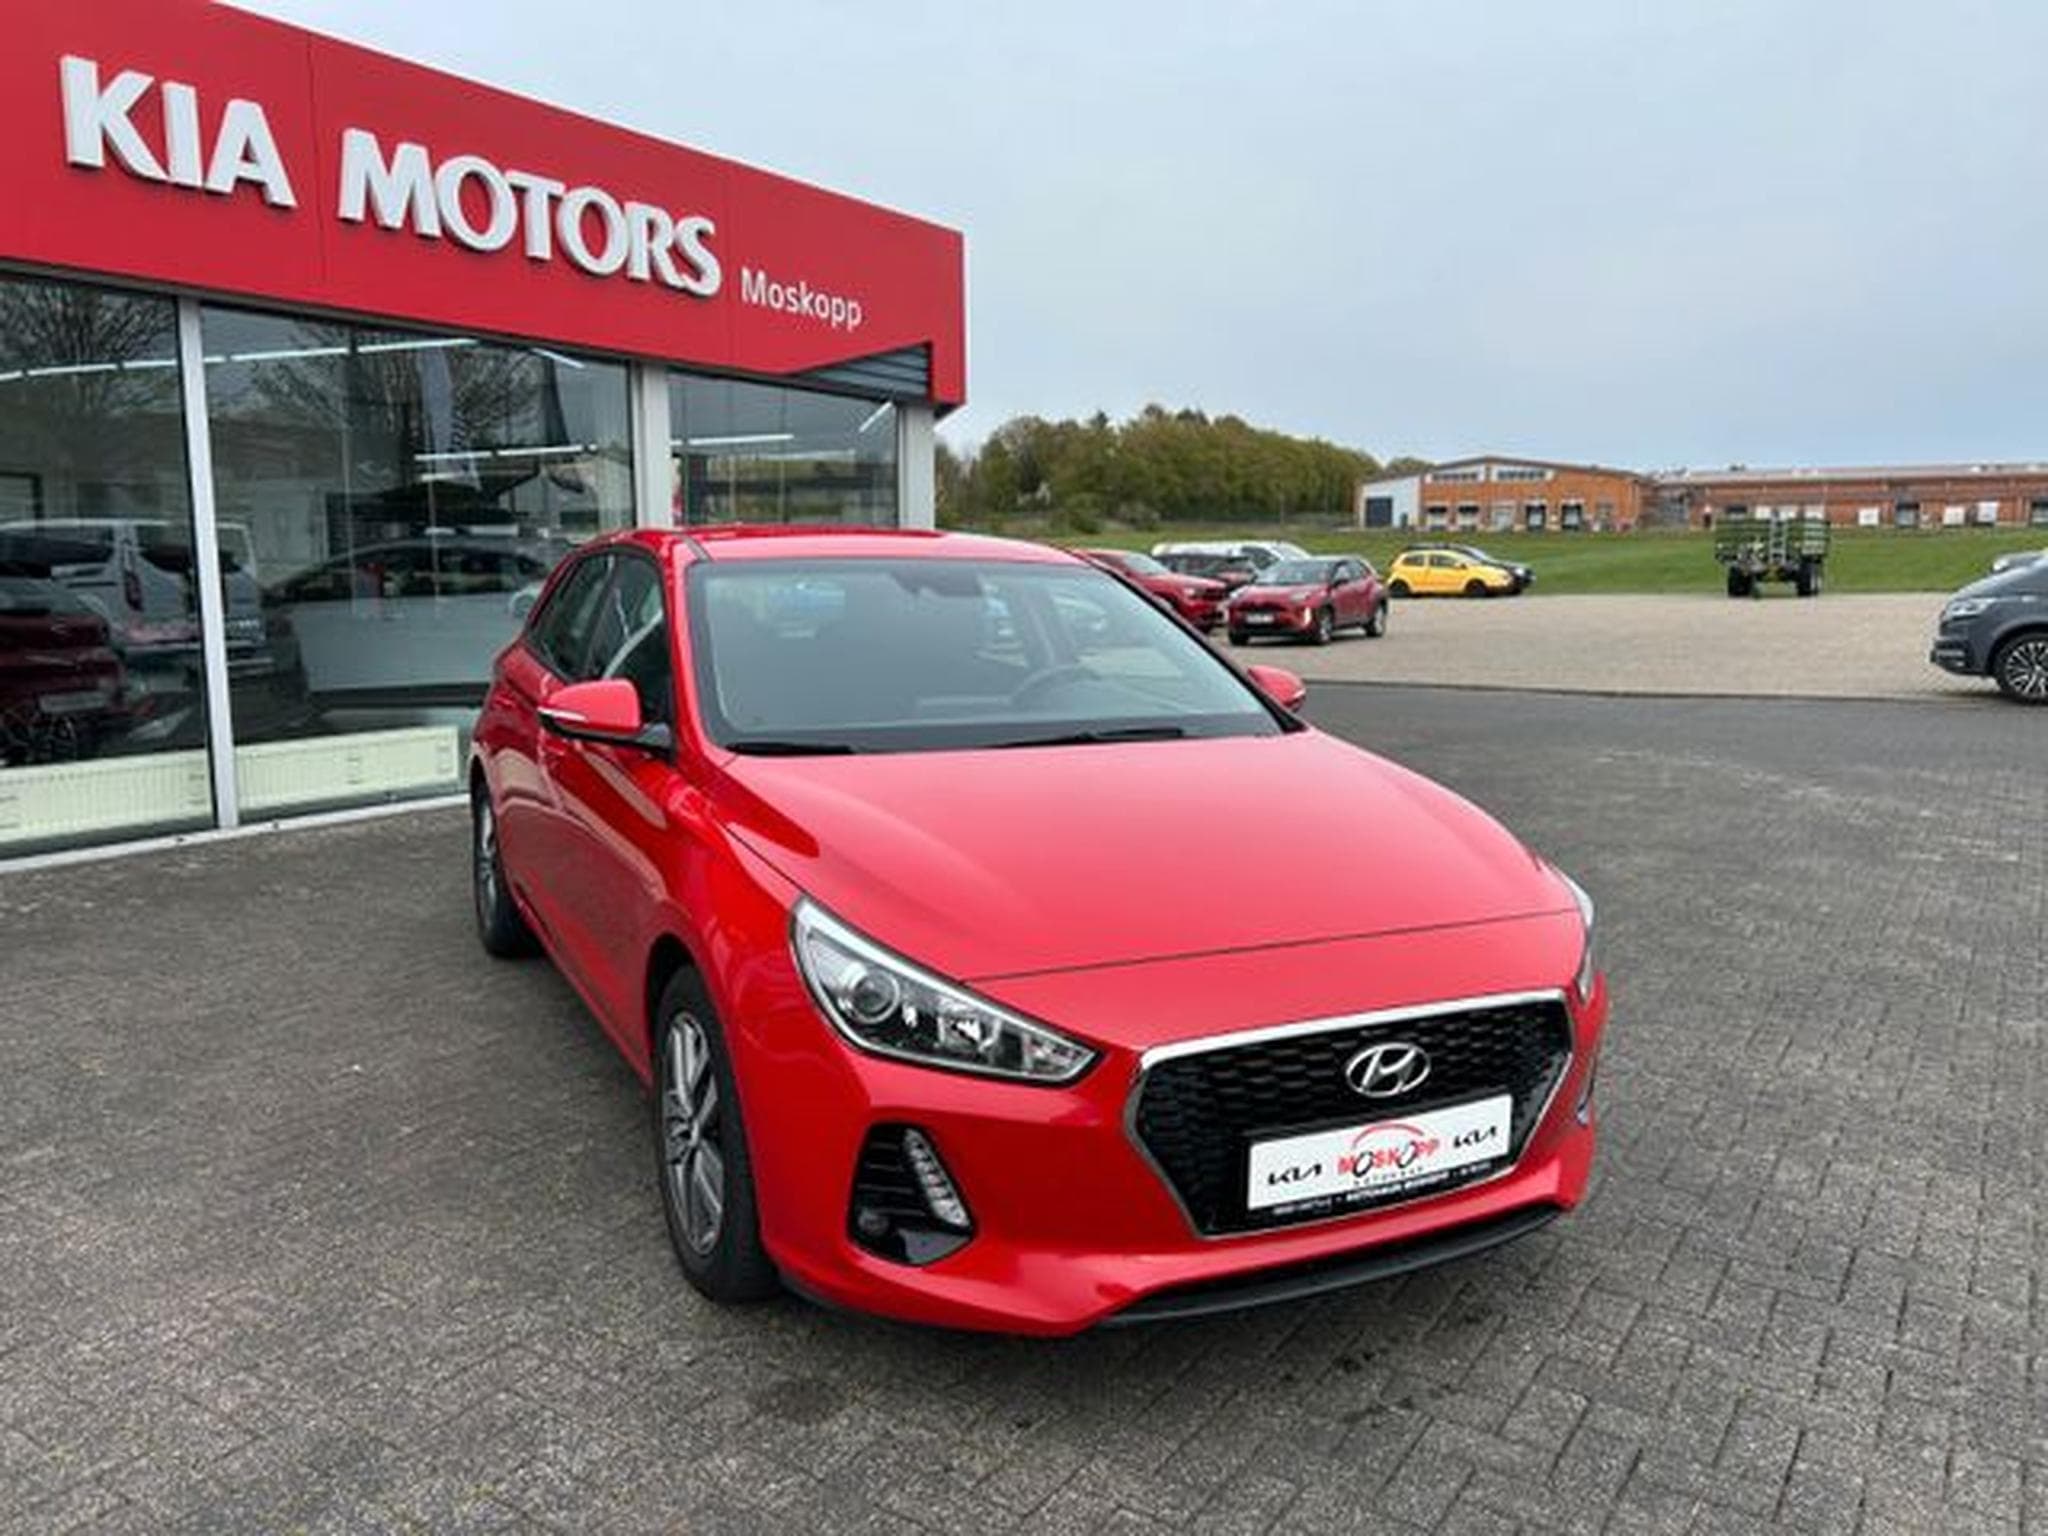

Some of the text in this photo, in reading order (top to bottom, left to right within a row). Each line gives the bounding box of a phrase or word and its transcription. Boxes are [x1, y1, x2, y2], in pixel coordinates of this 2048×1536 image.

[60, 54, 722, 298] KIA MOTORS
[741, 266, 862, 333] Moskopp
